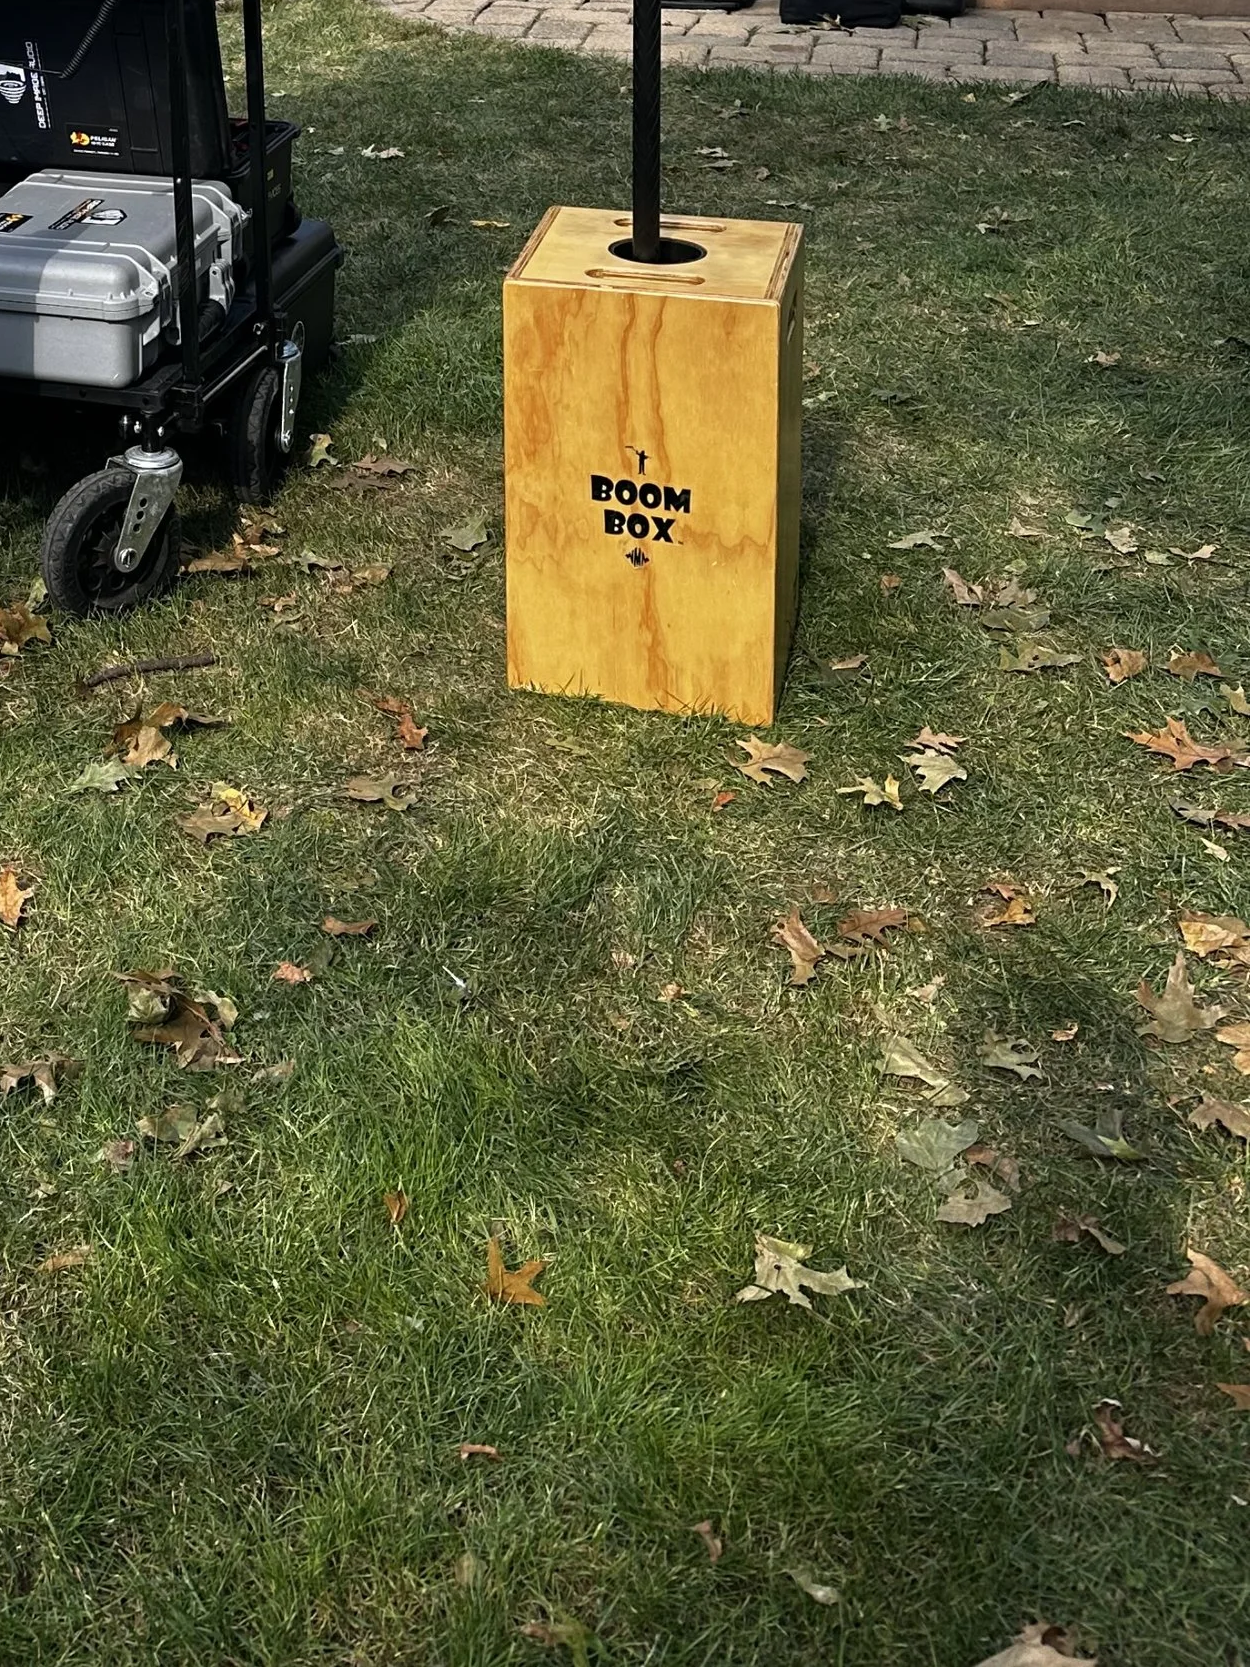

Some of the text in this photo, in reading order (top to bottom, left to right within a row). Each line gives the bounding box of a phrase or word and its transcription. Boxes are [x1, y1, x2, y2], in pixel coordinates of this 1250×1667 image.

[35, 102, 47, 129] DEEP
[590, 474, 691, 514] BOOM
[603, 508, 676, 544] BOX
